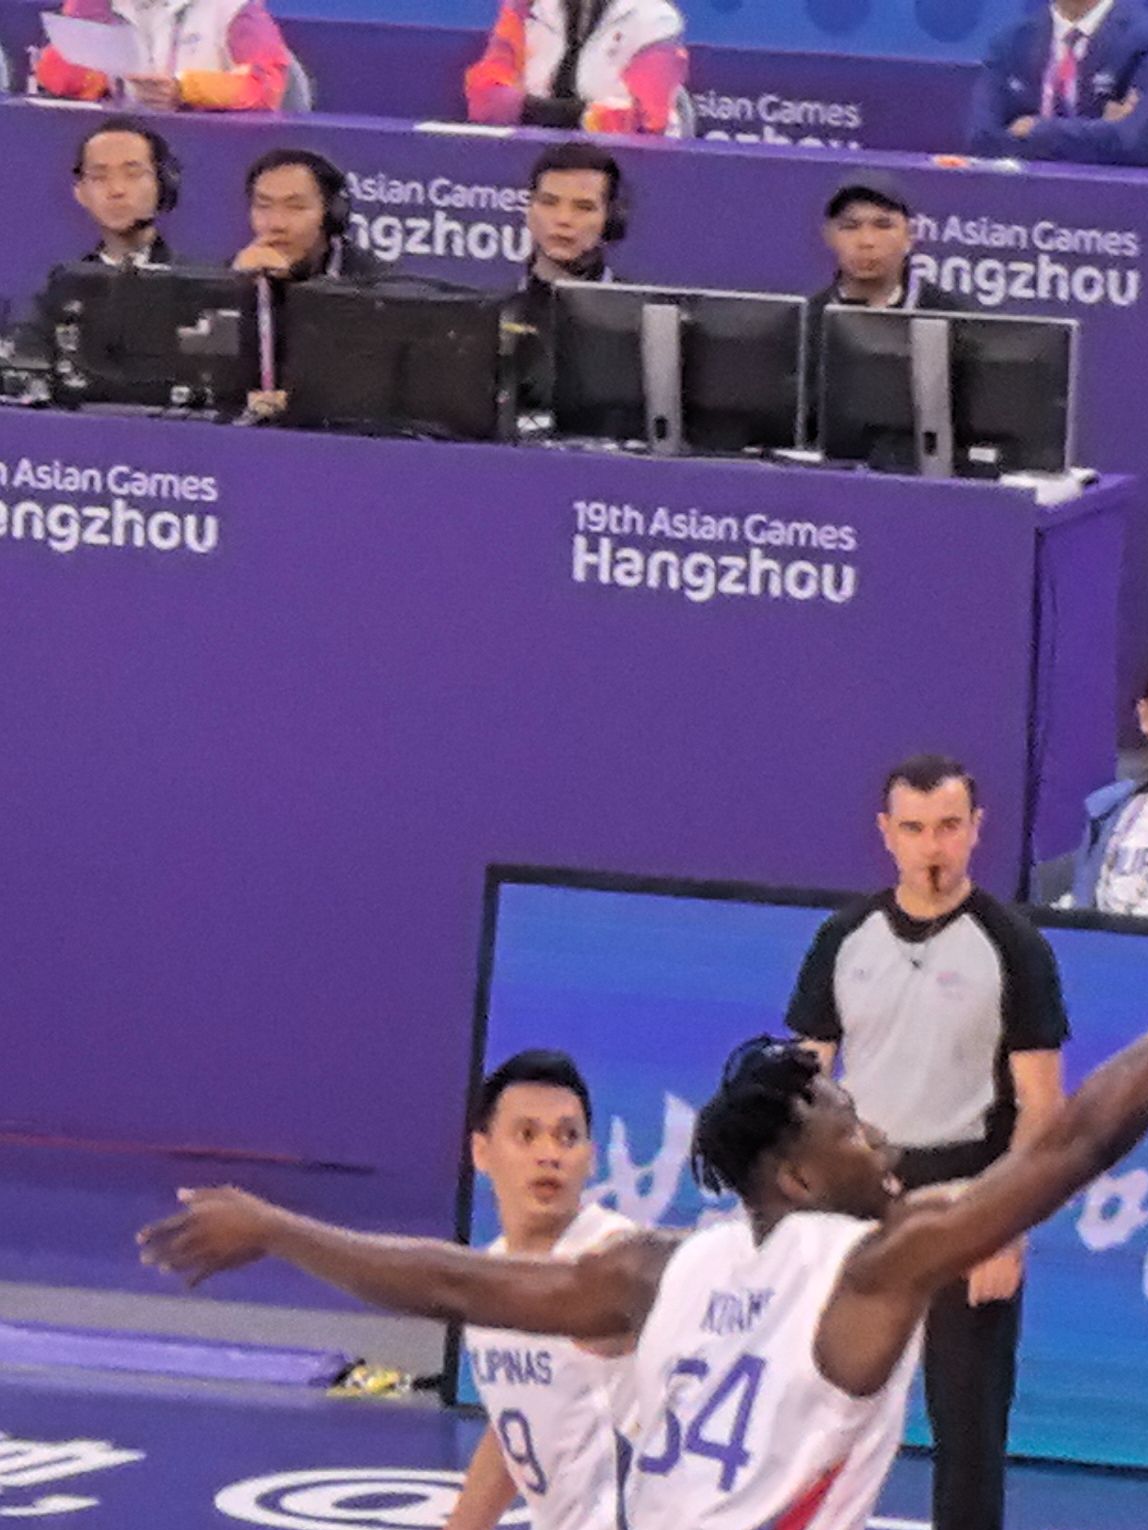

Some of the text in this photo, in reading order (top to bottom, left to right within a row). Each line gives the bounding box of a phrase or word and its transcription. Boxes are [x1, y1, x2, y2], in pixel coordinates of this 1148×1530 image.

[691, 90, 862, 129] sian Games
[428, 176, 532, 213] Games
[349, 209, 534, 263] ngzhou
[942, 214, 1029, 249] Asian
[1031, 219, 1141, 257] Games
[909, 253, 1142, 306] angzhou
[12, 456, 103, 494] Asian
[105, 464, 219, 502] Games
[0, 498, 219, 553] ngzhou
[573, 500, 858, 552] 19th Asian Games
[572, 533, 857, 603] Hangzhou
[637, 1353, 766, 1492] 54
[498, 1408, 548, 1496] 9
